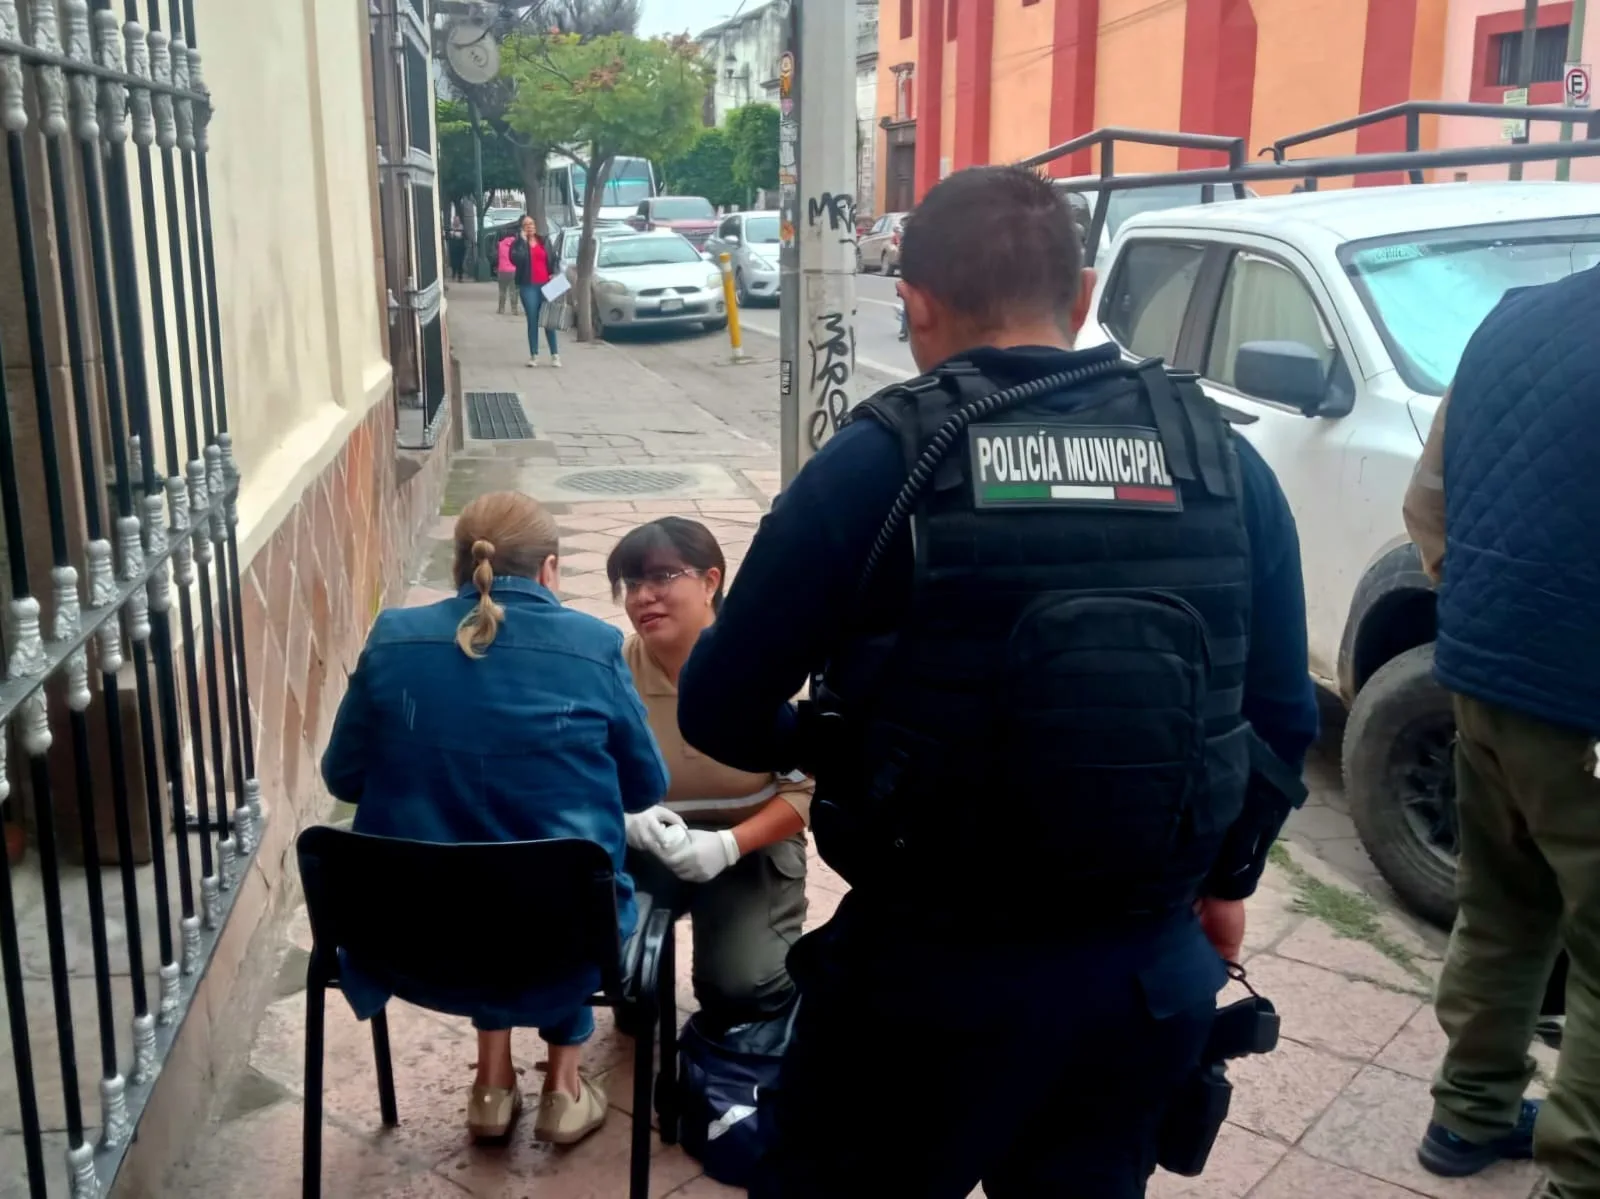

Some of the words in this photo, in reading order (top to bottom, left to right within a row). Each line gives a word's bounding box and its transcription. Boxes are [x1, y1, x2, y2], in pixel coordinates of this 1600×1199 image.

[1571, 74, 1583, 94] E
[976, 430, 1062, 482] POLICÍA
[1063, 436, 1173, 487] MUNICIPAL
